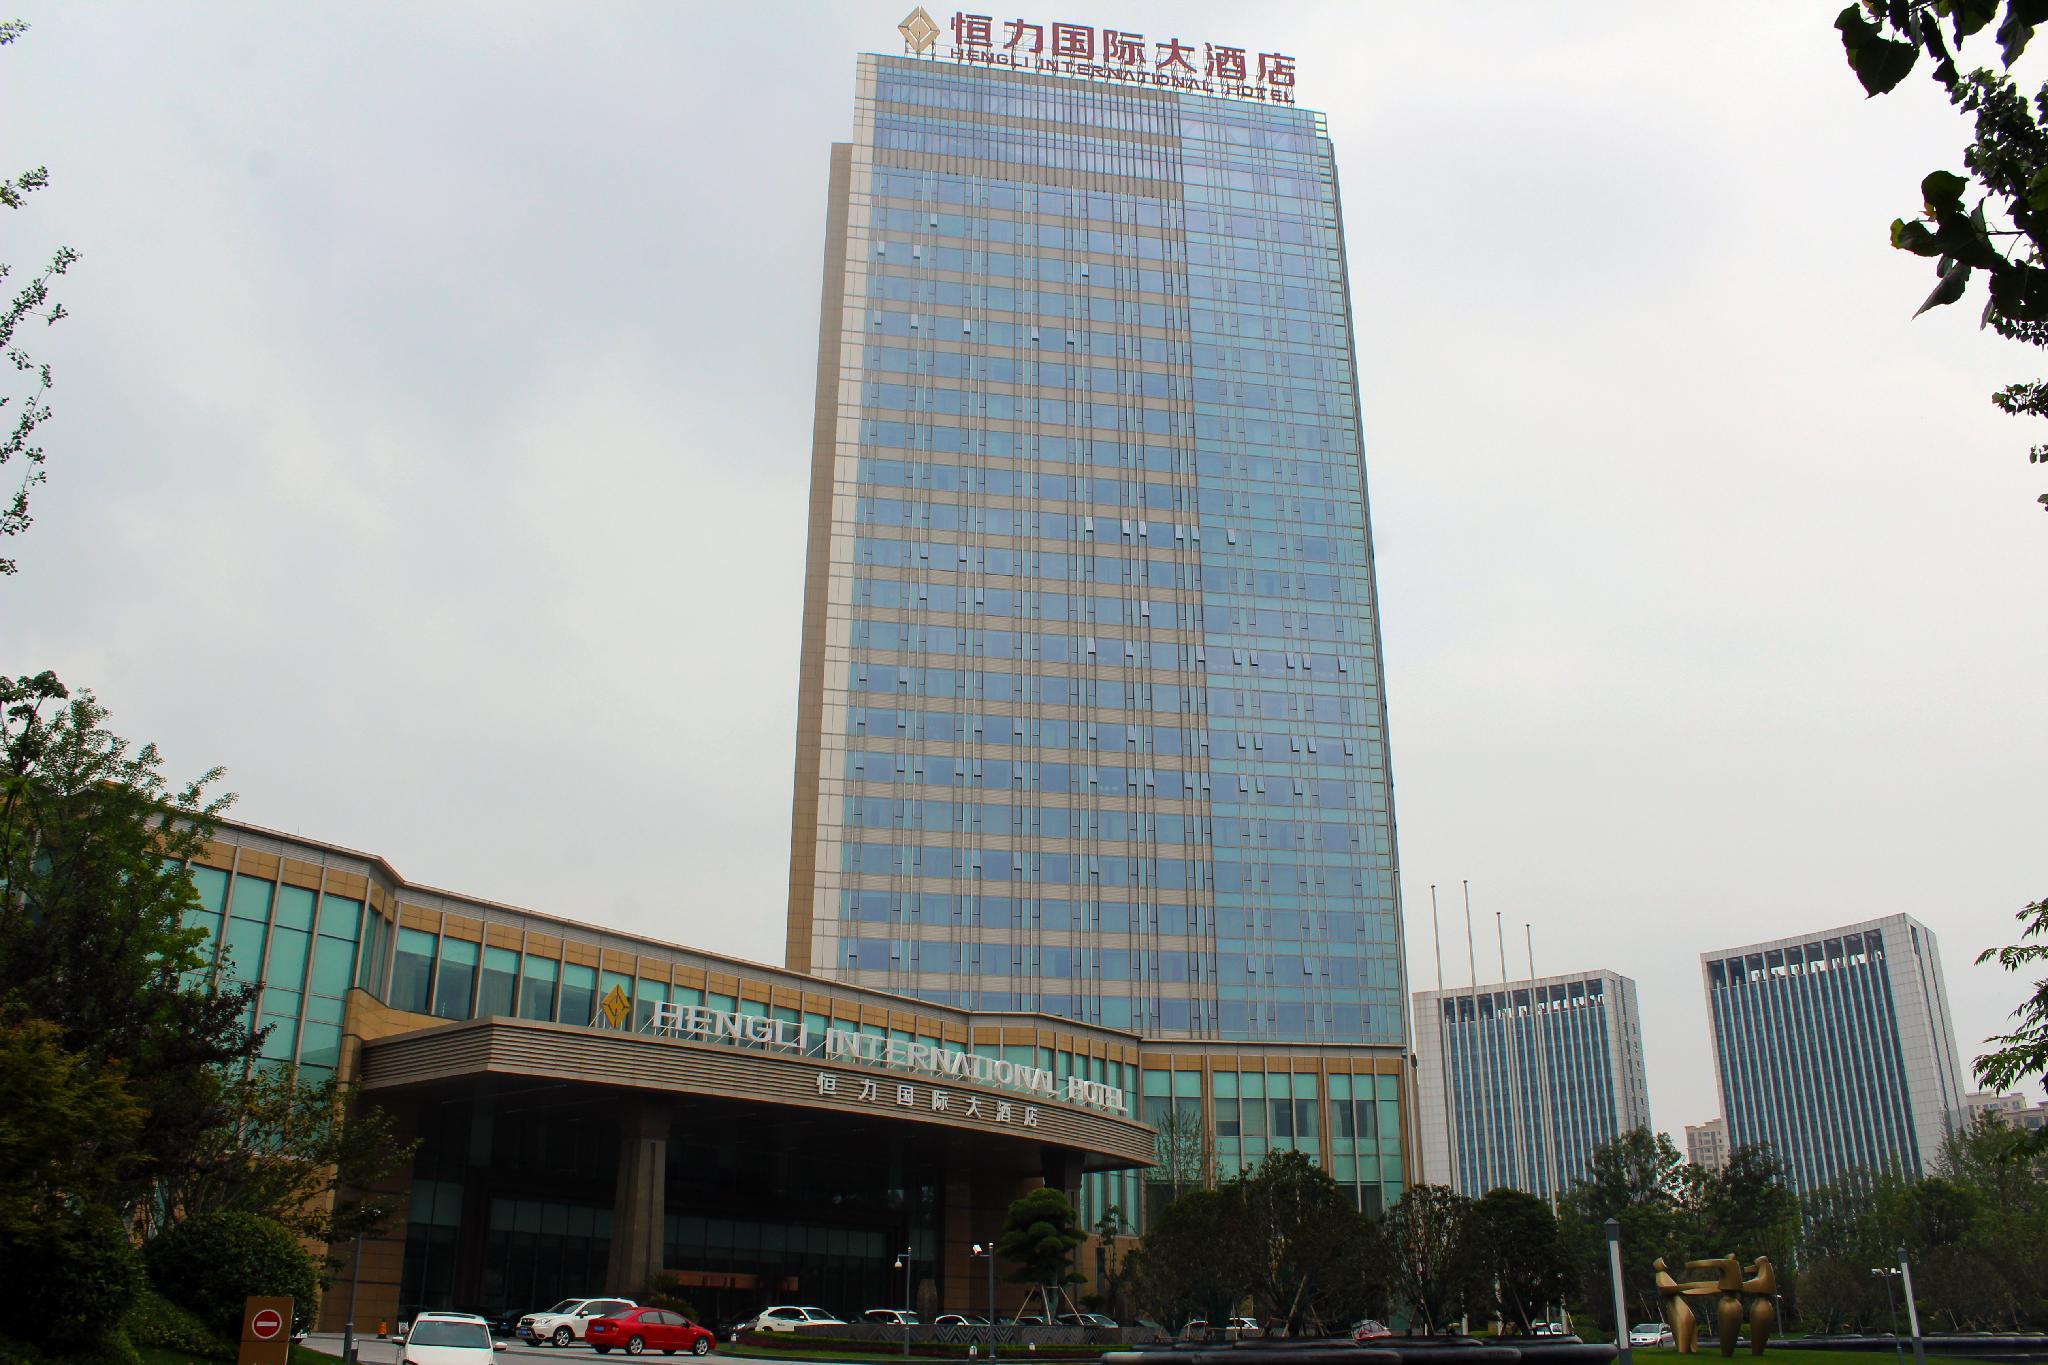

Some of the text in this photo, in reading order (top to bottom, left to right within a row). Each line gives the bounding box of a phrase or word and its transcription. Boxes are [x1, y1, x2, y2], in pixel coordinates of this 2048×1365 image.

[950, 47, 1295, 102] HENGLI INTERNATIONAL HOTEL
[951, 12, 1296, 87] 恒力国际大酒店
[652, 1000, 1127, 1111] HENGLI INTERNATIONAL HOTEL
[816, 1072, 1038, 1127] 恒力国际大酒店
